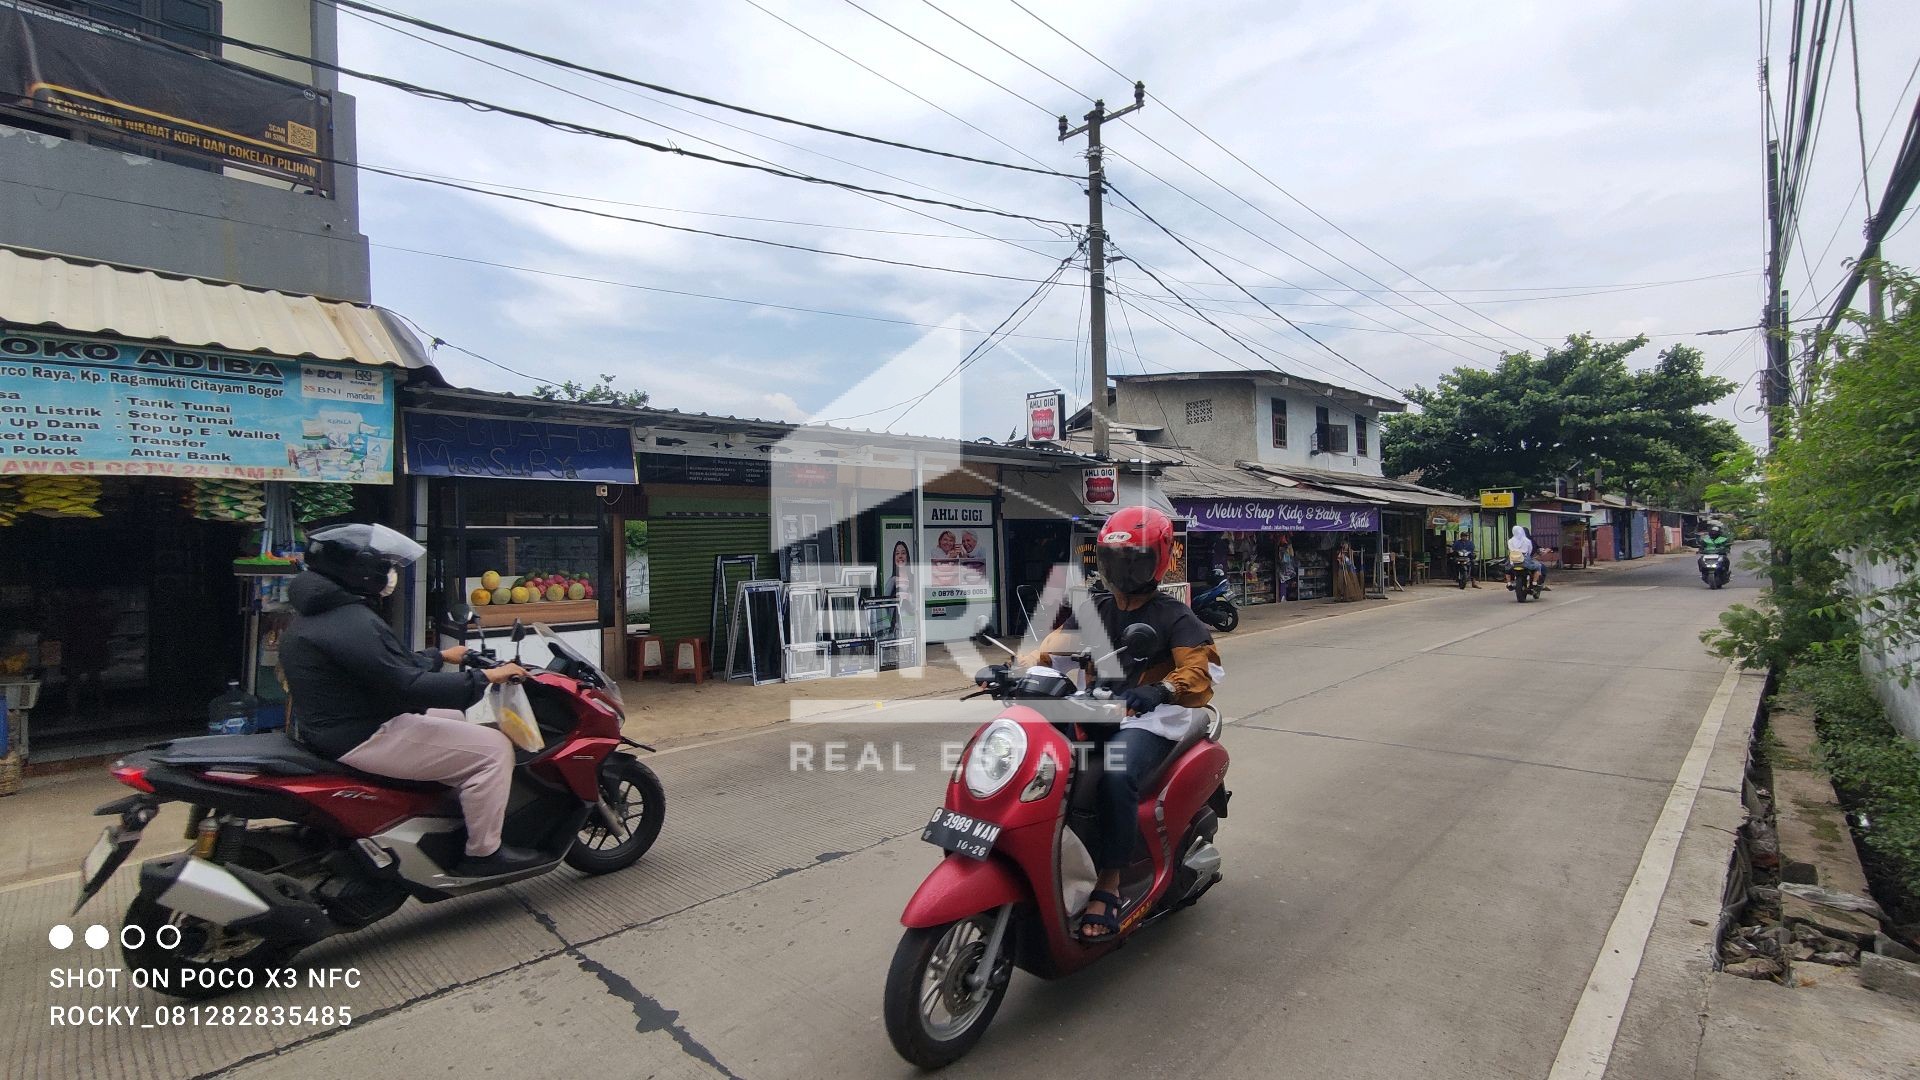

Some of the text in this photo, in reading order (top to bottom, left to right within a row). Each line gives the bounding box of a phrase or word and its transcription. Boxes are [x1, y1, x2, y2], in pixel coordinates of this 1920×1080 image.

[268, 124, 286, 135] SCAN
[125, 120, 171, 139] NIKMAT
[174, 131, 201, 147] KOPI
[203, 139, 226, 154] DAN
[228, 144, 275, 166] COKELAT
[277, 157, 316, 177] PILIHAN
[137, 348, 284, 378] ADIBA
[32, 366, 76, 382] Raya,
[81, 371, 105, 384] Kp.
[111, 373, 186, 388] Ragamukti
[191, 379, 244, 395] Citayam
[248, 385, 284, 399] Bogor
[318, 386, 341, 396] BNI
[127, 397, 231, 413] Tarik Tunai
[1029, 398, 1056, 410] AHLI GIGI
[36, 405, 102, 418] Listrik
[128, 410, 233, 426] Setor Tunai
[10, 418, 39, 430] Up
[47, 419, 101, 431] Dana
[129, 422, 162, 434] Top
[169, 426, 193, 437] Up
[228, 430, 281, 441] Wallet
[34, 433, 82, 443] Data
[130, 436, 207, 449] Transfer
[14, 446, 79, 456] Pokok
[131, 448, 231, 462] Antar Bank
[1084, 468, 1115, 477] AHLI GIGI
[931, 508, 983, 522] AHLI GIGI
[1206, 502, 1243, 520] Nelvi
[1245, 503, 1276, 525] Shop
[1306, 508, 1313, 519] &
[1315, 506, 1343, 525] Baby
[931, 808, 943, 822] B
[943, 812, 973, 833] 3989
